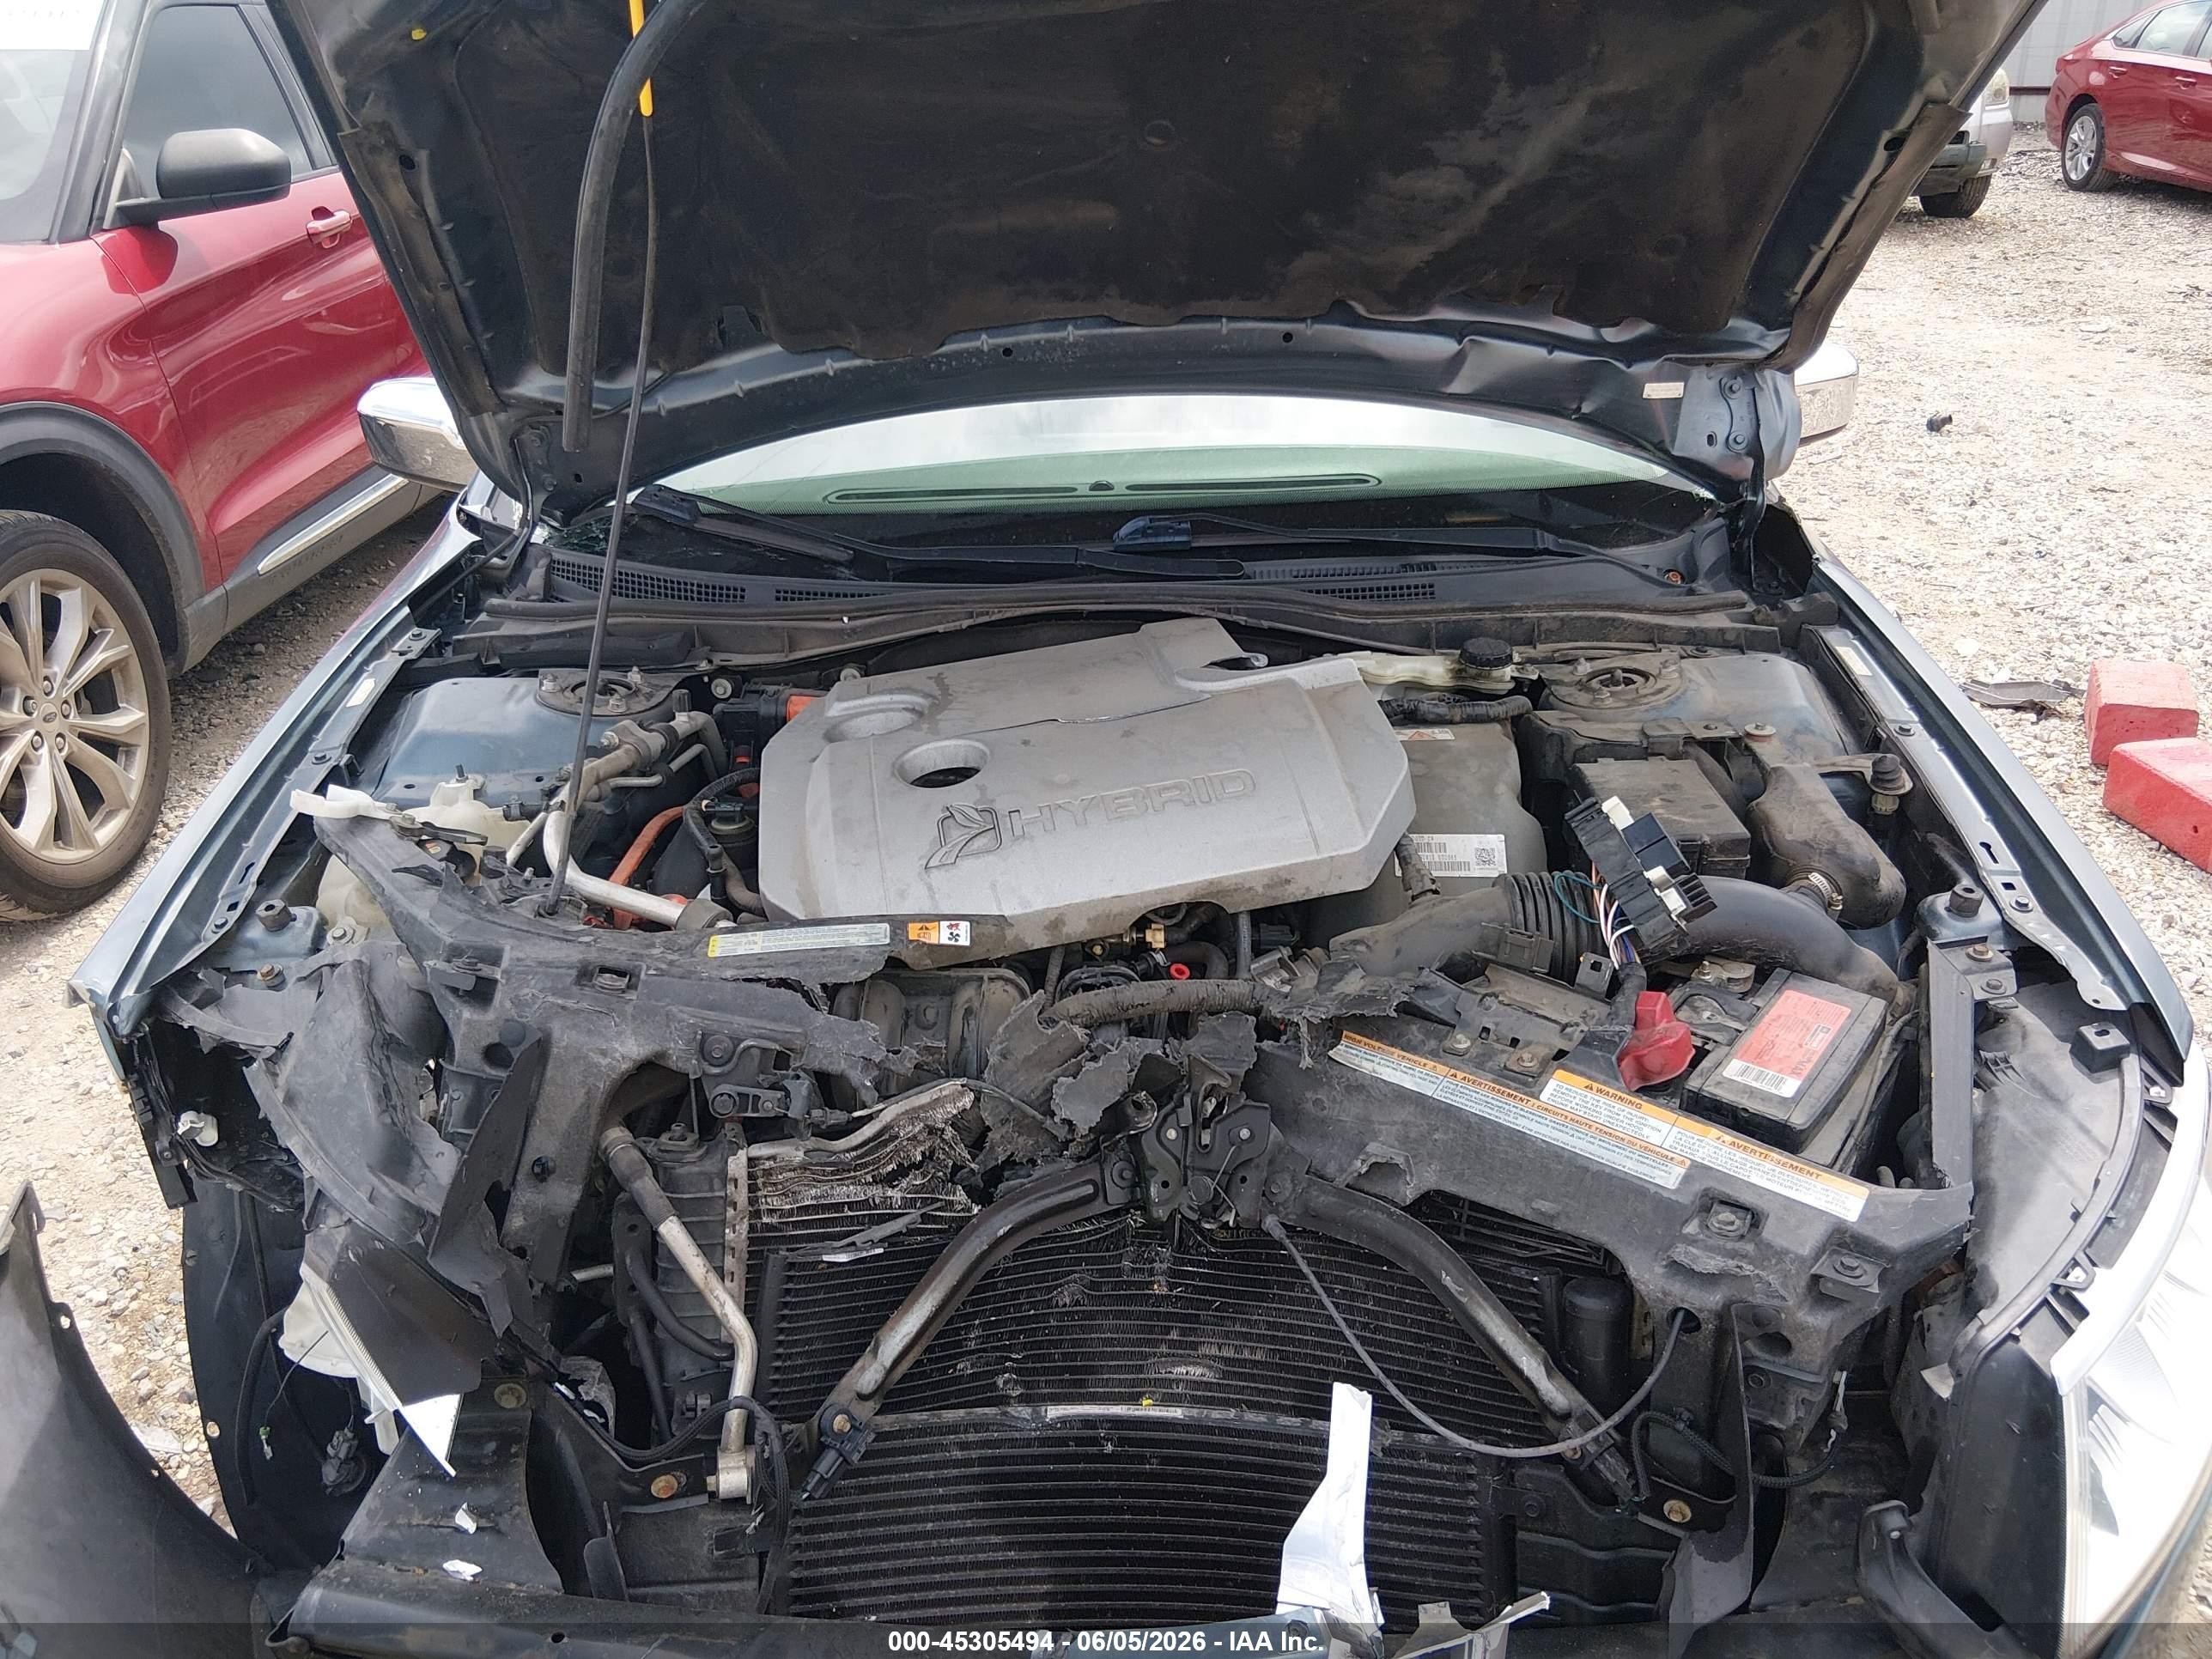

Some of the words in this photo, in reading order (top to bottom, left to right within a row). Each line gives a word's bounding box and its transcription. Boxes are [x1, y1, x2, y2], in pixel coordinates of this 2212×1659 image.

[1007, 768, 1257, 839] HYBRID
[1342, 1034, 1363, 1044] HIGH
[1395, 1053, 1429, 1068] VEHICLE
[1461, 1074, 1531, 1106] AVERTISSEMENT
[1535, 1103, 1568, 1120] CIRCUITS
[1569, 1116, 1593, 1130] HAUTE
[1594, 1126, 1626, 1143] TENSION
[1626, 1139, 1638, 1147] DU
[1546, 1096, 1569, 1109] ENGINE
[1568, 1104, 1582, 1113] MAY
[1549, 1091, 1573, 1104] BEFORE
[1573, 1101, 1603, 1116] WORKING
[1602, 1112, 1625, 1124] UNDER
[1552, 1087, 1577, 1100] REMOVE
[1602, 1107, 1621, 1117] FROM
[1621, 1114, 1634, 1122] THE
[1634, 1119, 1662, 1133] IGNITION
[1564, 1086, 1588, 1098] REDUCE
[1601, 1101, 1616, 1109] RISK
[1594, 1086, 1644, 1109] WARNING
[1675, 1130, 1696, 1140] POUR
[1728, 1140, 1822, 1180] AVERTISSEMENT
